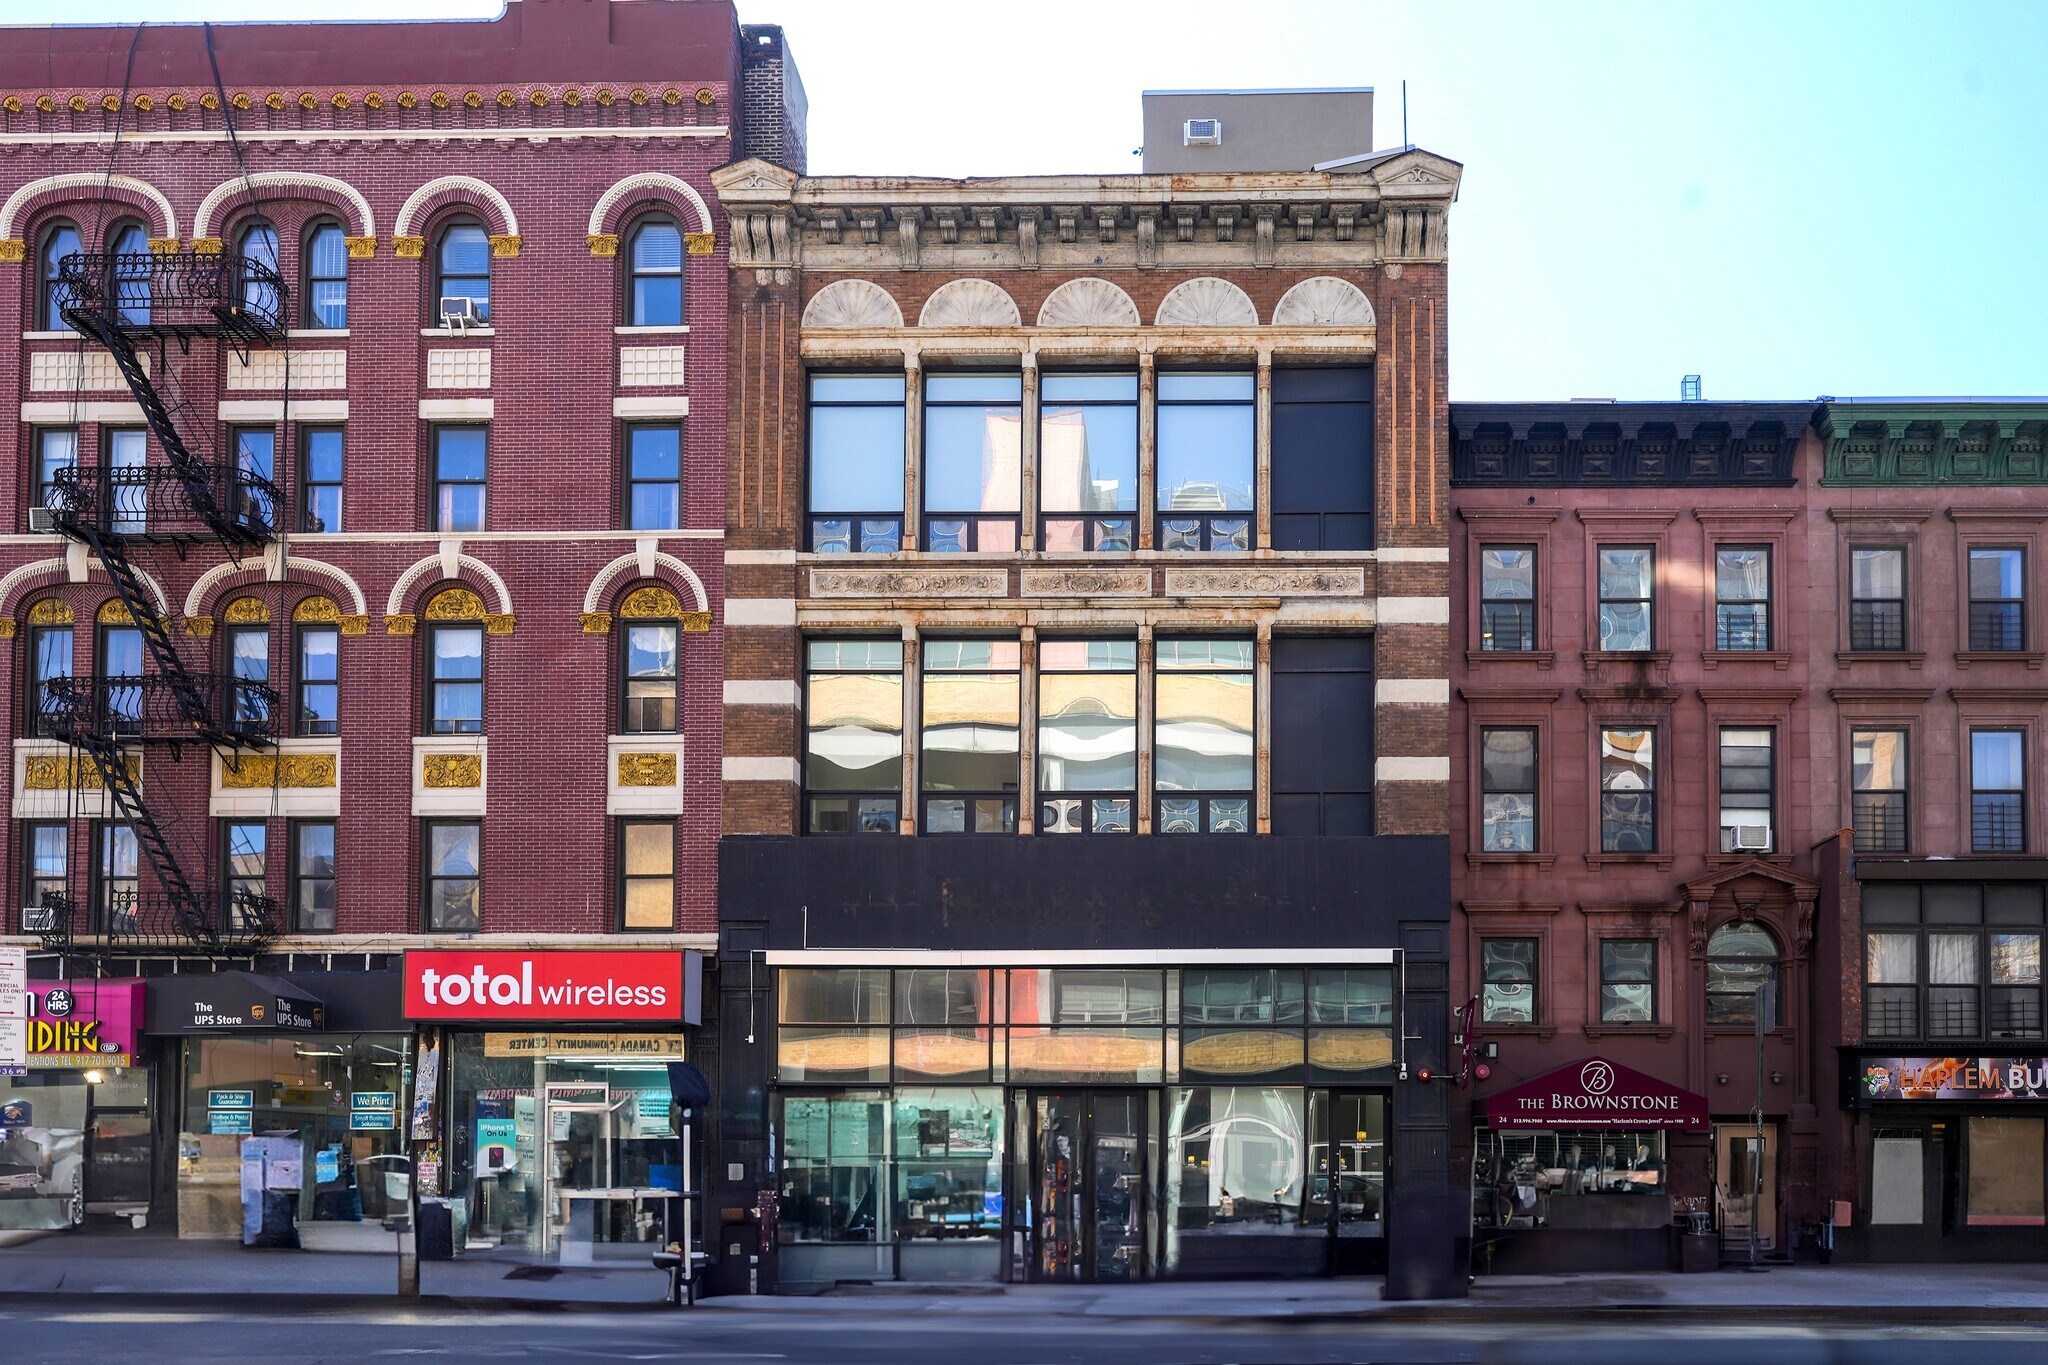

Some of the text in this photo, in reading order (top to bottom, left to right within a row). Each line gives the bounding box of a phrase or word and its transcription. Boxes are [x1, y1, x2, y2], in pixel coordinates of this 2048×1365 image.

[422, 960, 667, 1006] total wireless
[51, 991, 65, 1000] 24
[47, 1000, 69, 1011] HRS
[194, 1002, 213, 1012] The
[277, 998, 291, 1012] The
[194, 1014, 242, 1025] UPS Store
[277, 1013, 312, 1028] UPS Store
[76, 1056, 125, 1066] 917-701-9015
[1900, 1068, 2048, 1090] HARLEM BU
[357, 1096, 389, 1105] We Print
[1518, 1095, 1679, 1110] THE BROWNSTONE
